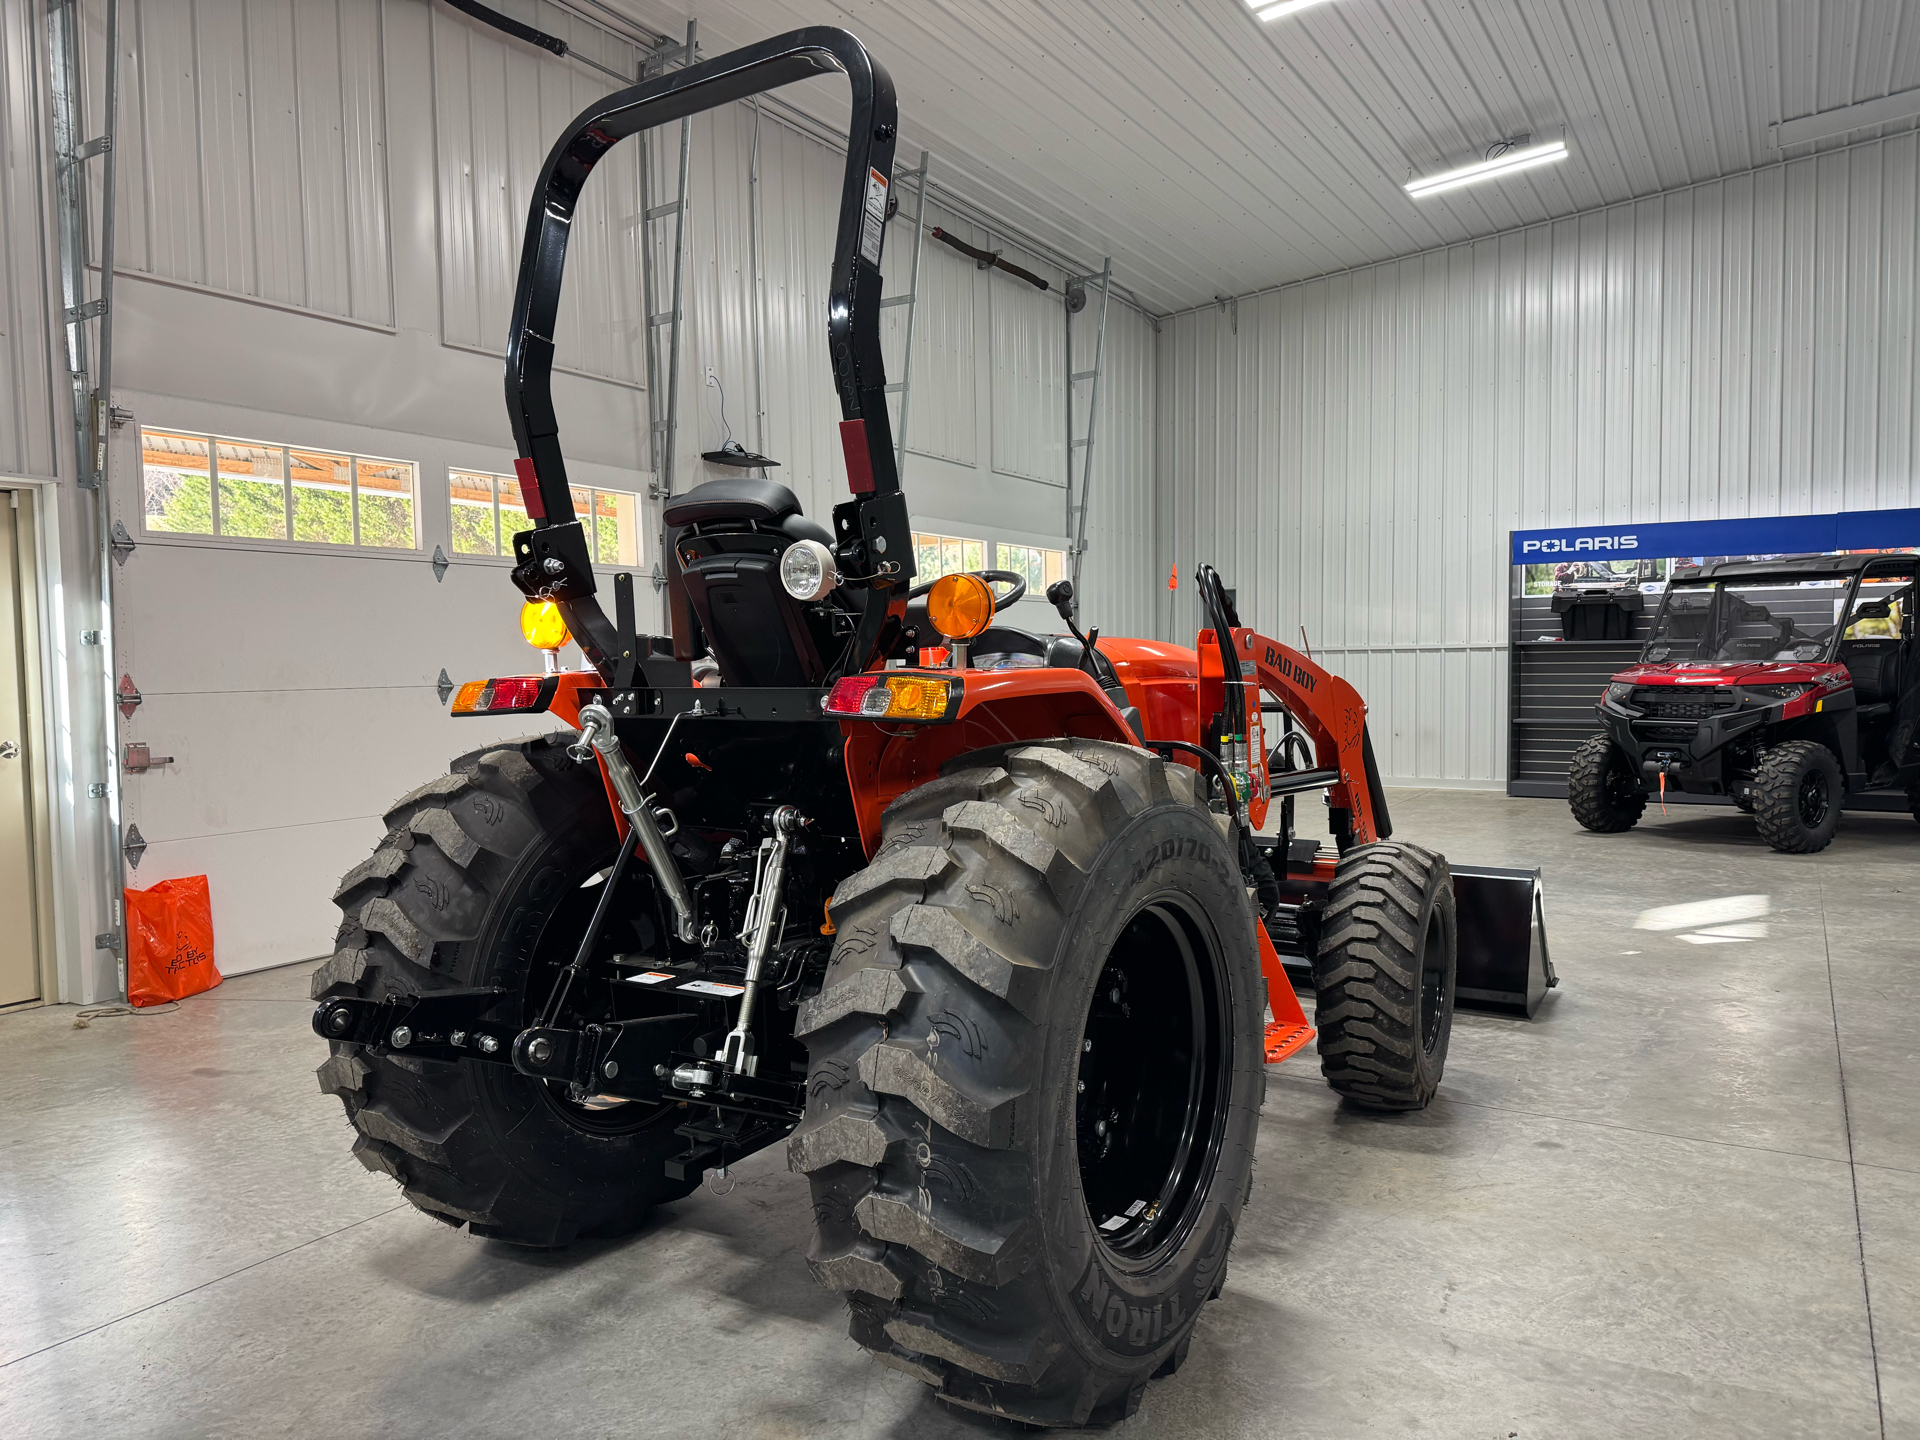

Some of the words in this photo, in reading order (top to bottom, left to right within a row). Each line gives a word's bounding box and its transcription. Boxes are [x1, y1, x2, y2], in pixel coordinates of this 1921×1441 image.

[1522, 535, 1639, 554] POLARIS
[1533, 580, 1562, 588] STORAGE
[1264, 645, 1293, 678] BAD
[1292, 664, 1318, 694] BOY
[186, 946, 199, 959] BY
